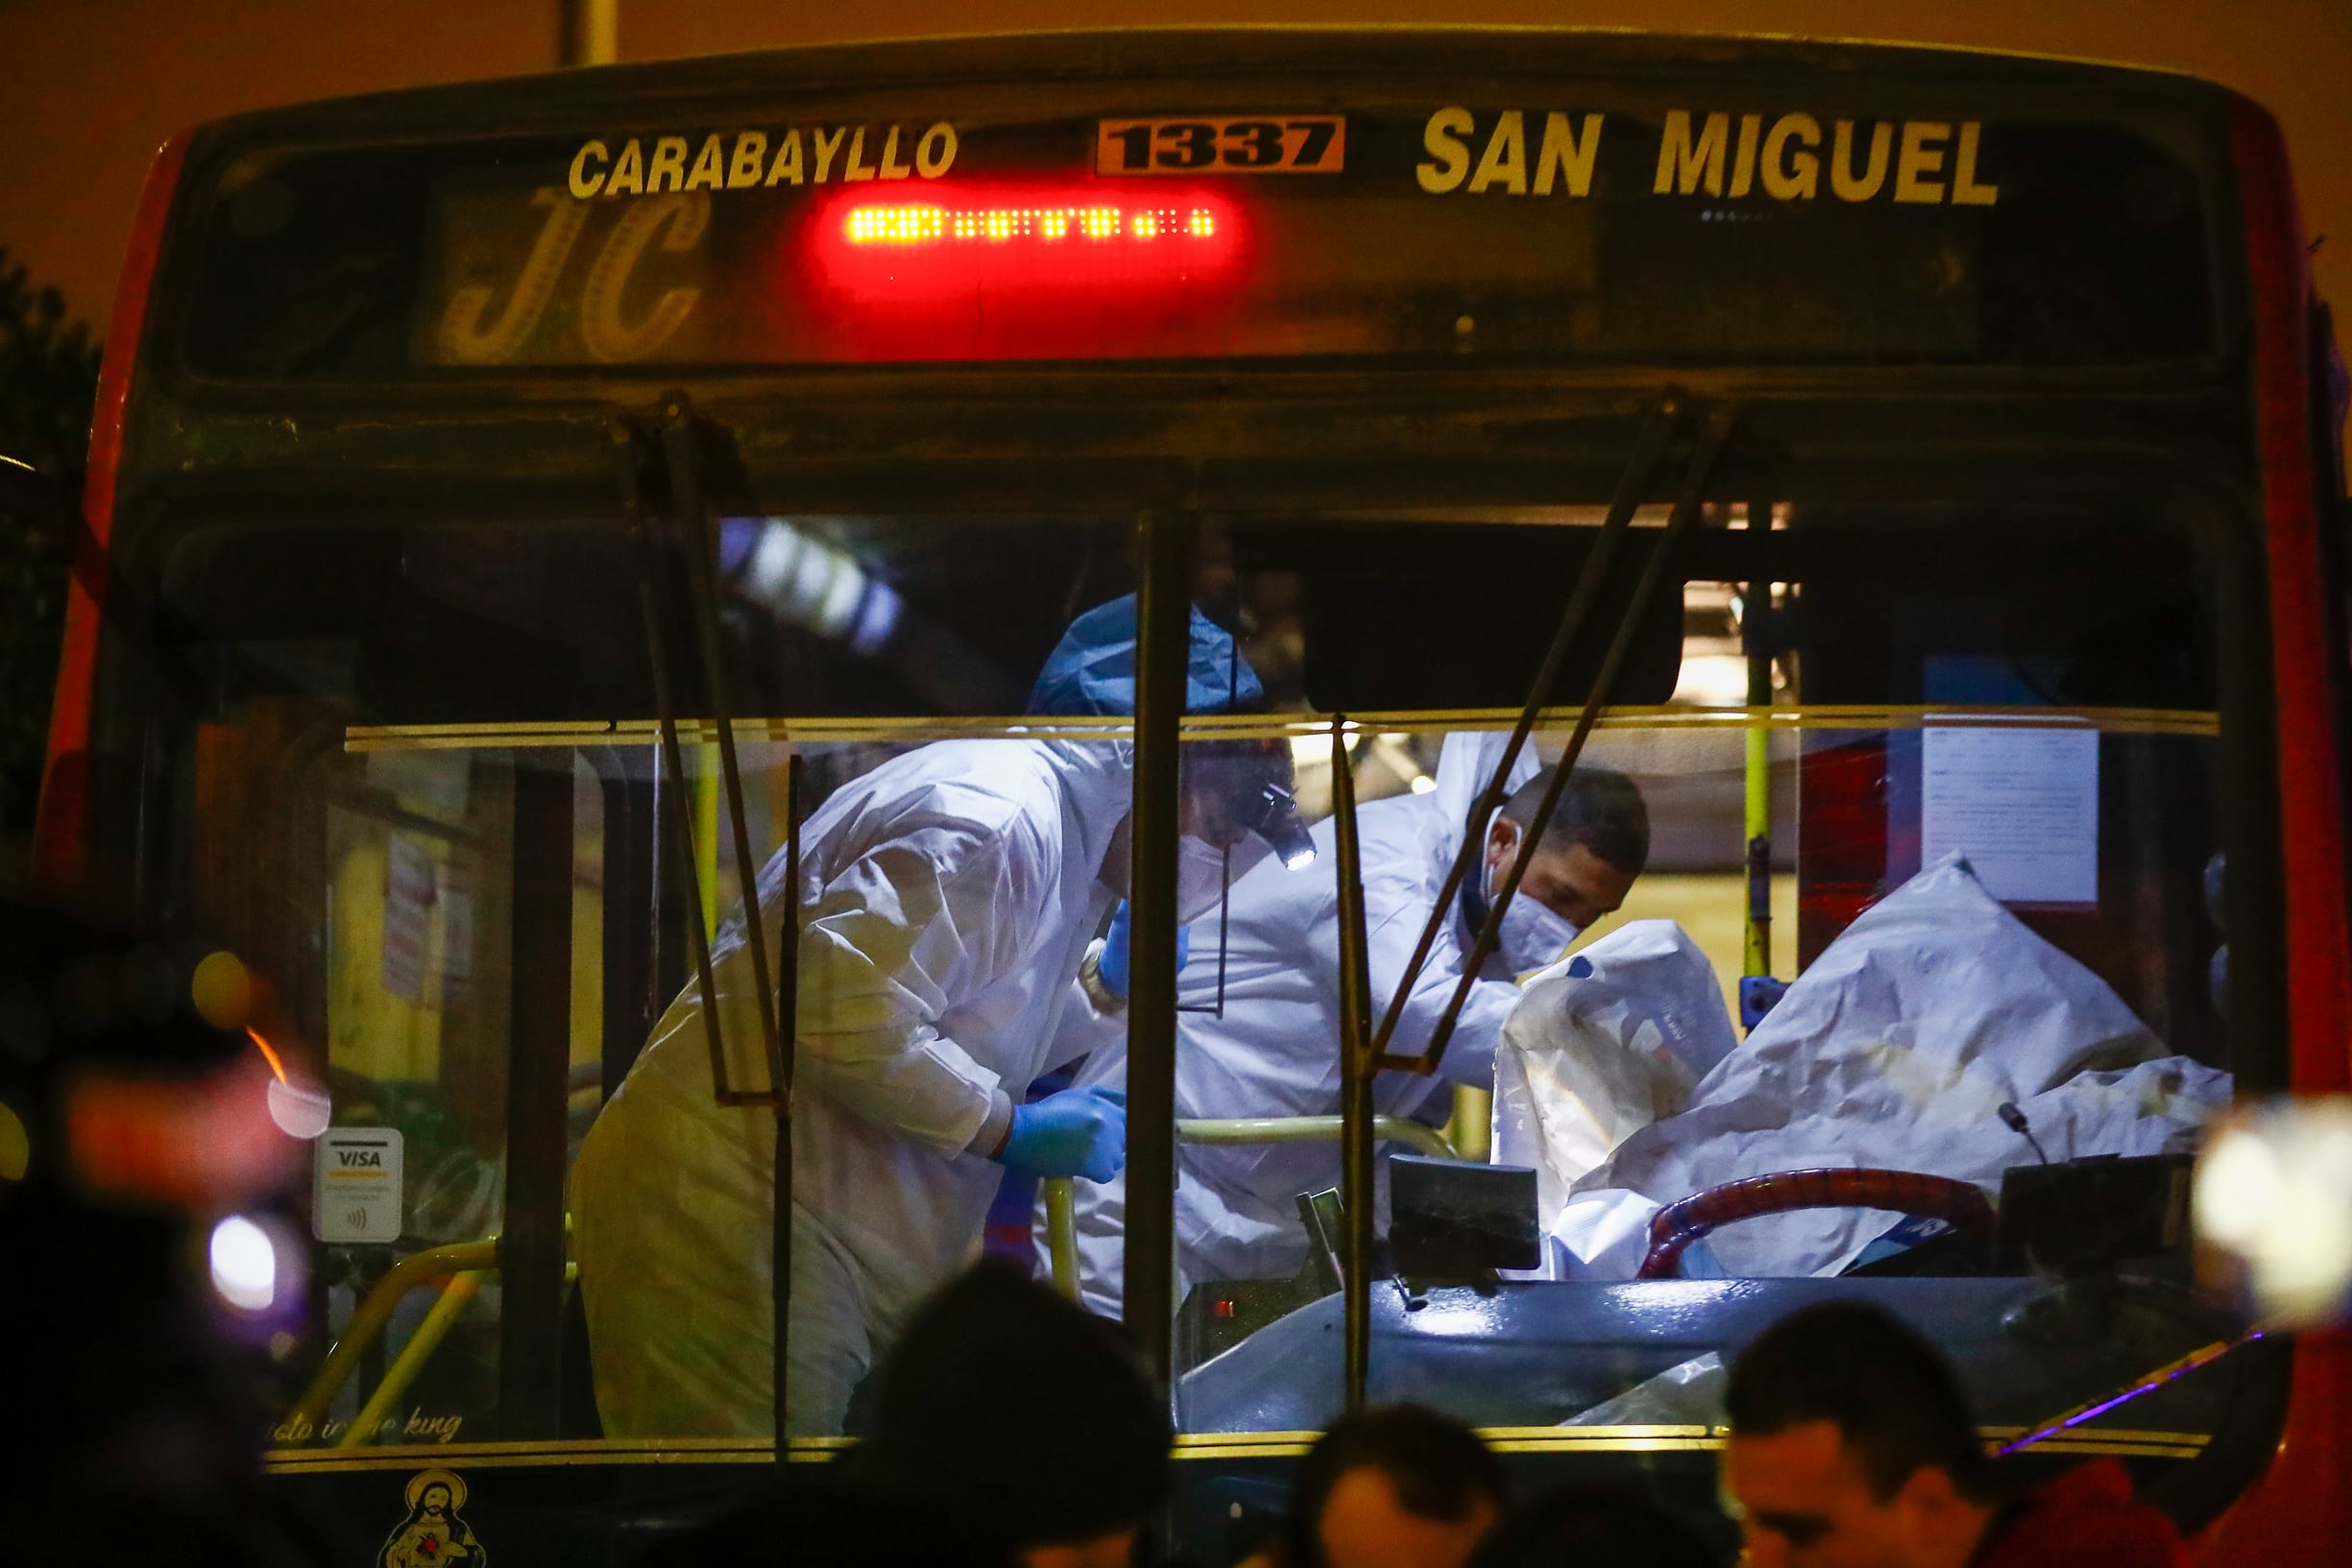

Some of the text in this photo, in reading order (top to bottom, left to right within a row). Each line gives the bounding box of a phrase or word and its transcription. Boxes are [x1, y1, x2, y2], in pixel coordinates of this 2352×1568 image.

[569, 122, 958, 200] CARABAYLLO
[1106, 122, 1336, 170] 1337
[1416, 107, 1999, 206] SAN MIGUEL
[439, 186, 712, 365] JC
[338, 1150, 381, 1168] VISA
